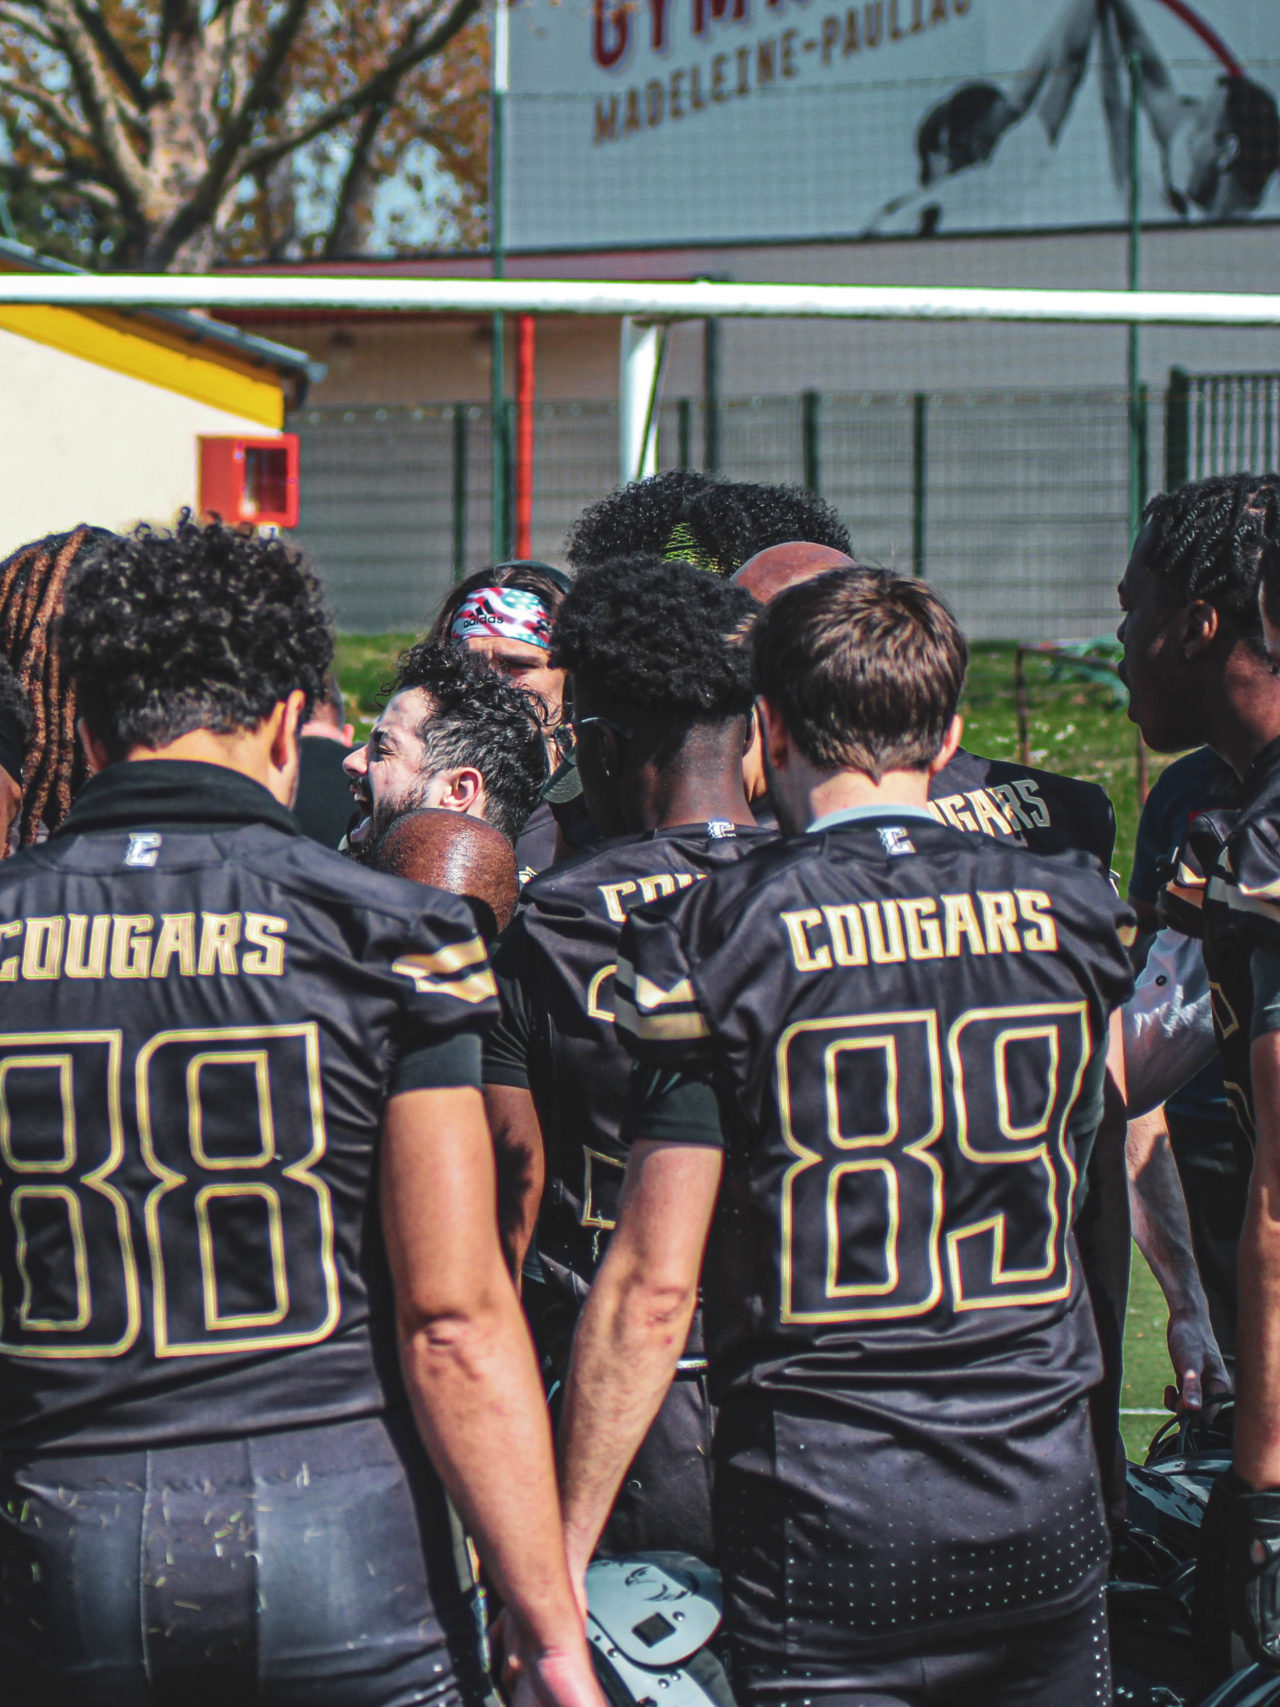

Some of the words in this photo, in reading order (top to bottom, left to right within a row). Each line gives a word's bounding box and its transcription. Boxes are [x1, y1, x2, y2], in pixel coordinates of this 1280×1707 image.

[463, 614, 504, 628] adidas
[780, 889, 1058, 972] COUGARS
[776, 1000, 1090, 1324] 89
